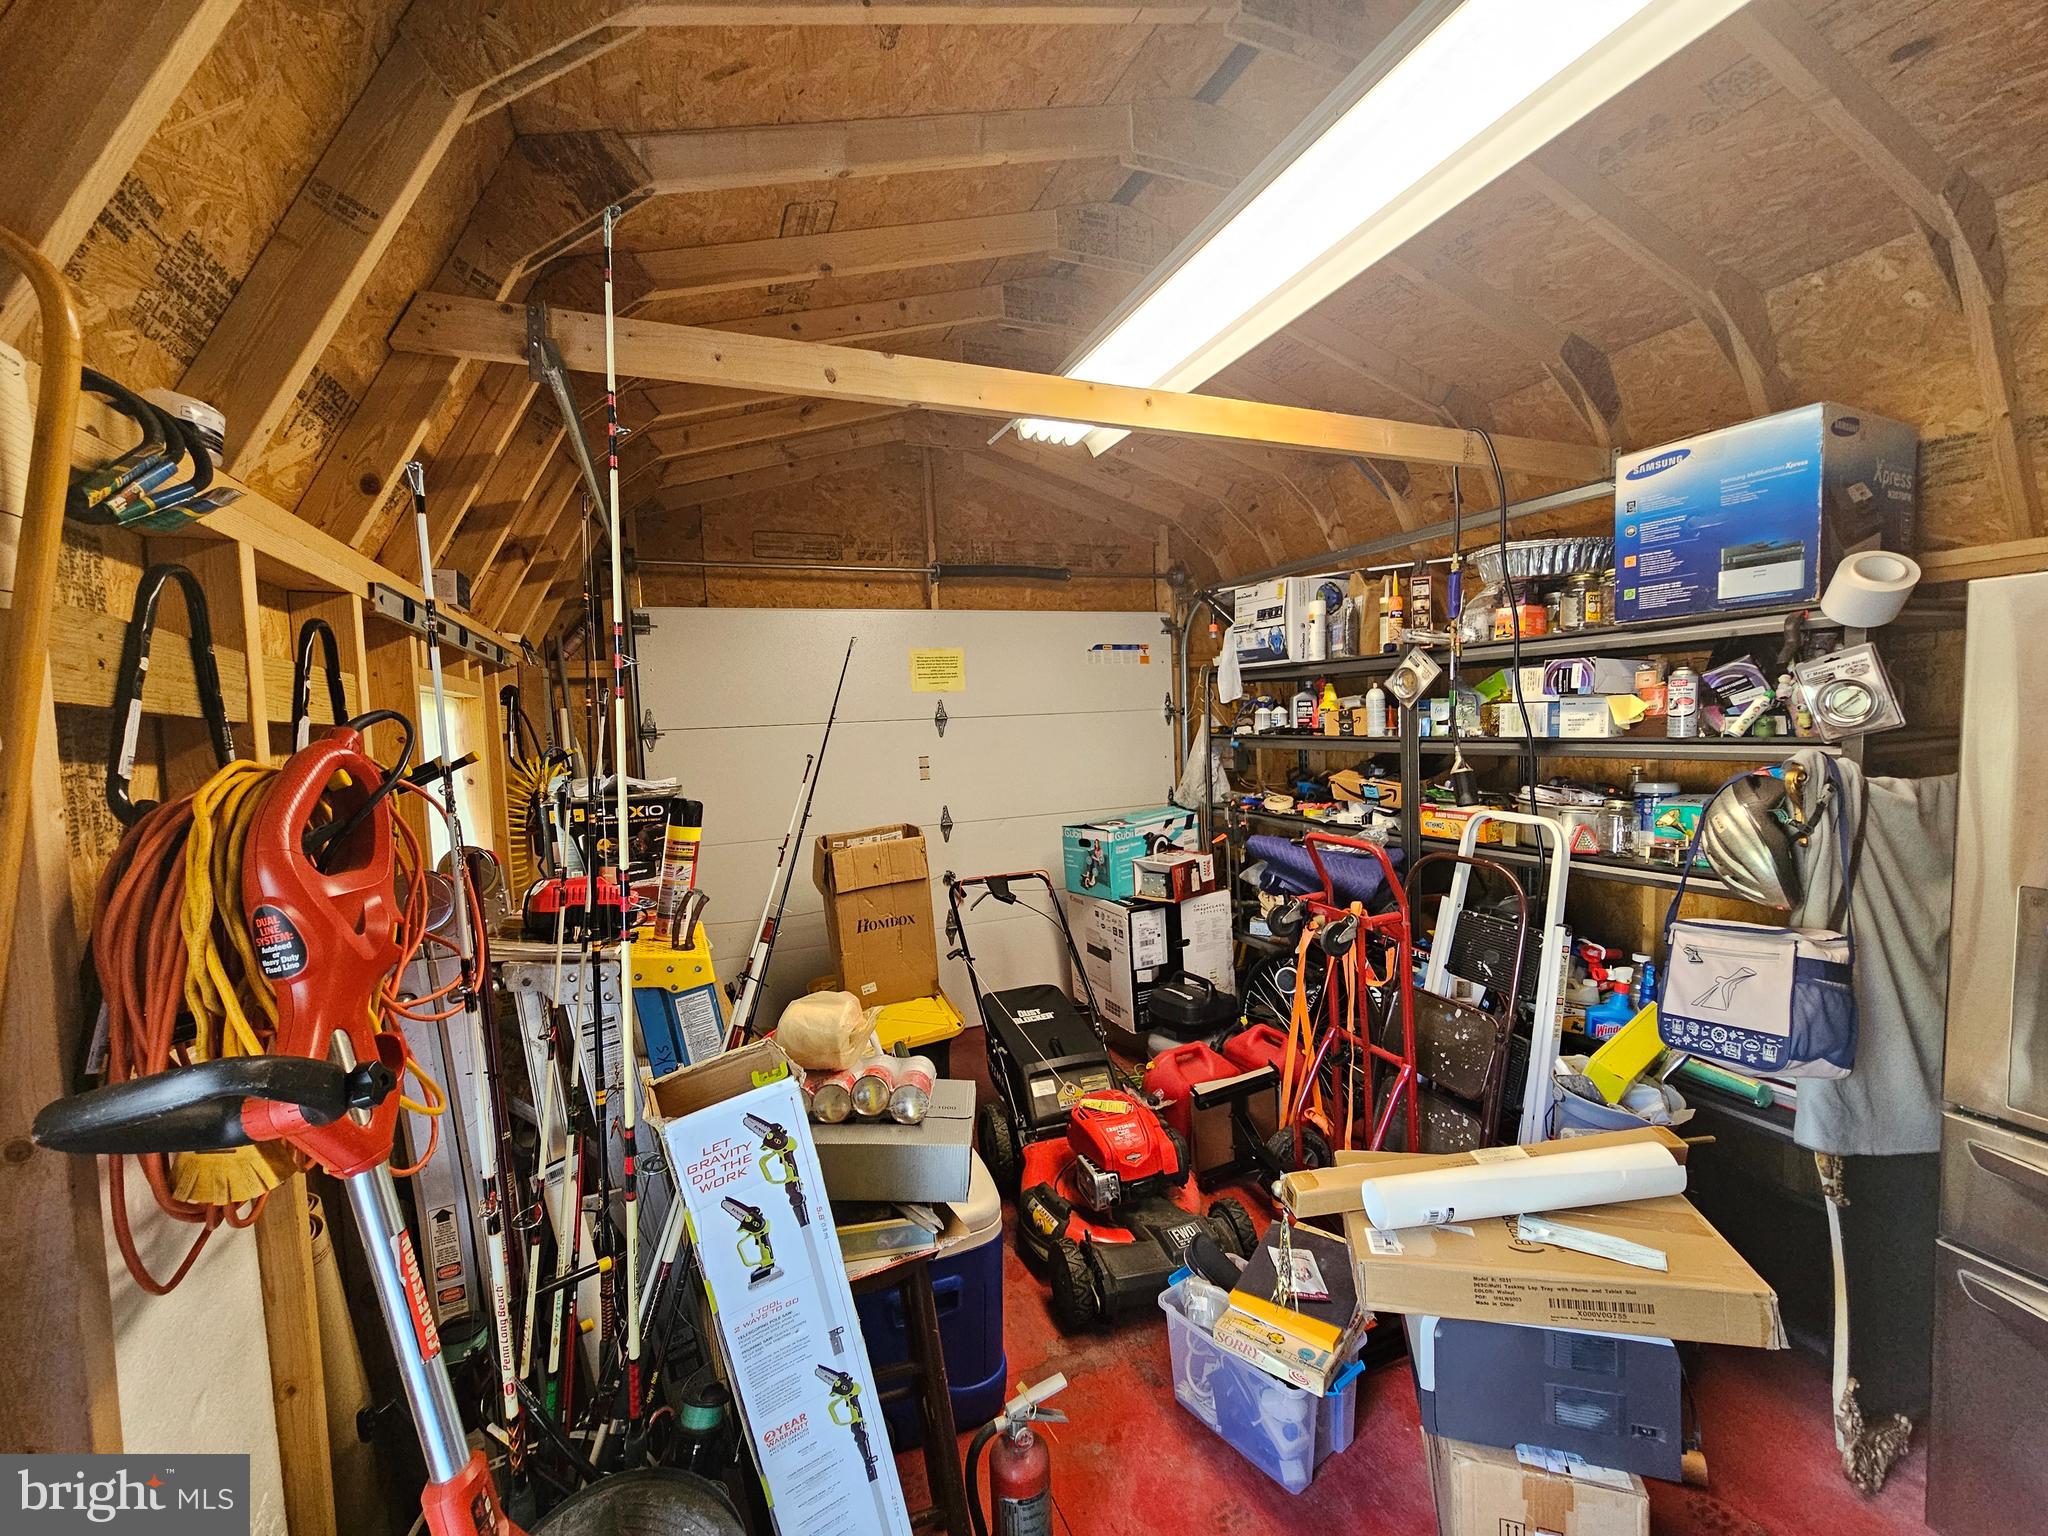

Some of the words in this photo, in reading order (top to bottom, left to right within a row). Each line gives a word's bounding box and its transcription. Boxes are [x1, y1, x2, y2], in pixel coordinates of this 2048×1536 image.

[1632, 455, 1684, 474] SAMSUNG
[1785, 459, 1809, 469] Xpress
[1873, 457, 1913, 489] Xpress
[256, 915, 280, 927] DUAL
[260, 924, 281, 937] LINE
[256, 931, 294, 946] SYSTEM:
[280, 954, 299, 964] Duty
[687, 1141, 752, 1175] GRAVITY
[702, 1137, 732, 1156] LET
[692, 1168, 716, 1186] DO
[721, 1153, 753, 1172] THE
[699, 1167, 748, 1193] WORK
[496, 1286, 506, 1317] Beach
[757, 1300, 782, 1314] TOOL
[500, 1318, 509, 1343] Long
[734, 1326, 740, 1334] 2
[743, 1312, 768, 1328] WAYS
[771, 1305, 783, 1314] TO
[503, 1344, 512, 1371] Penn
[766, 1421, 809, 1448] WARRANTY
[776, 1413, 807, 1434] YEAR
